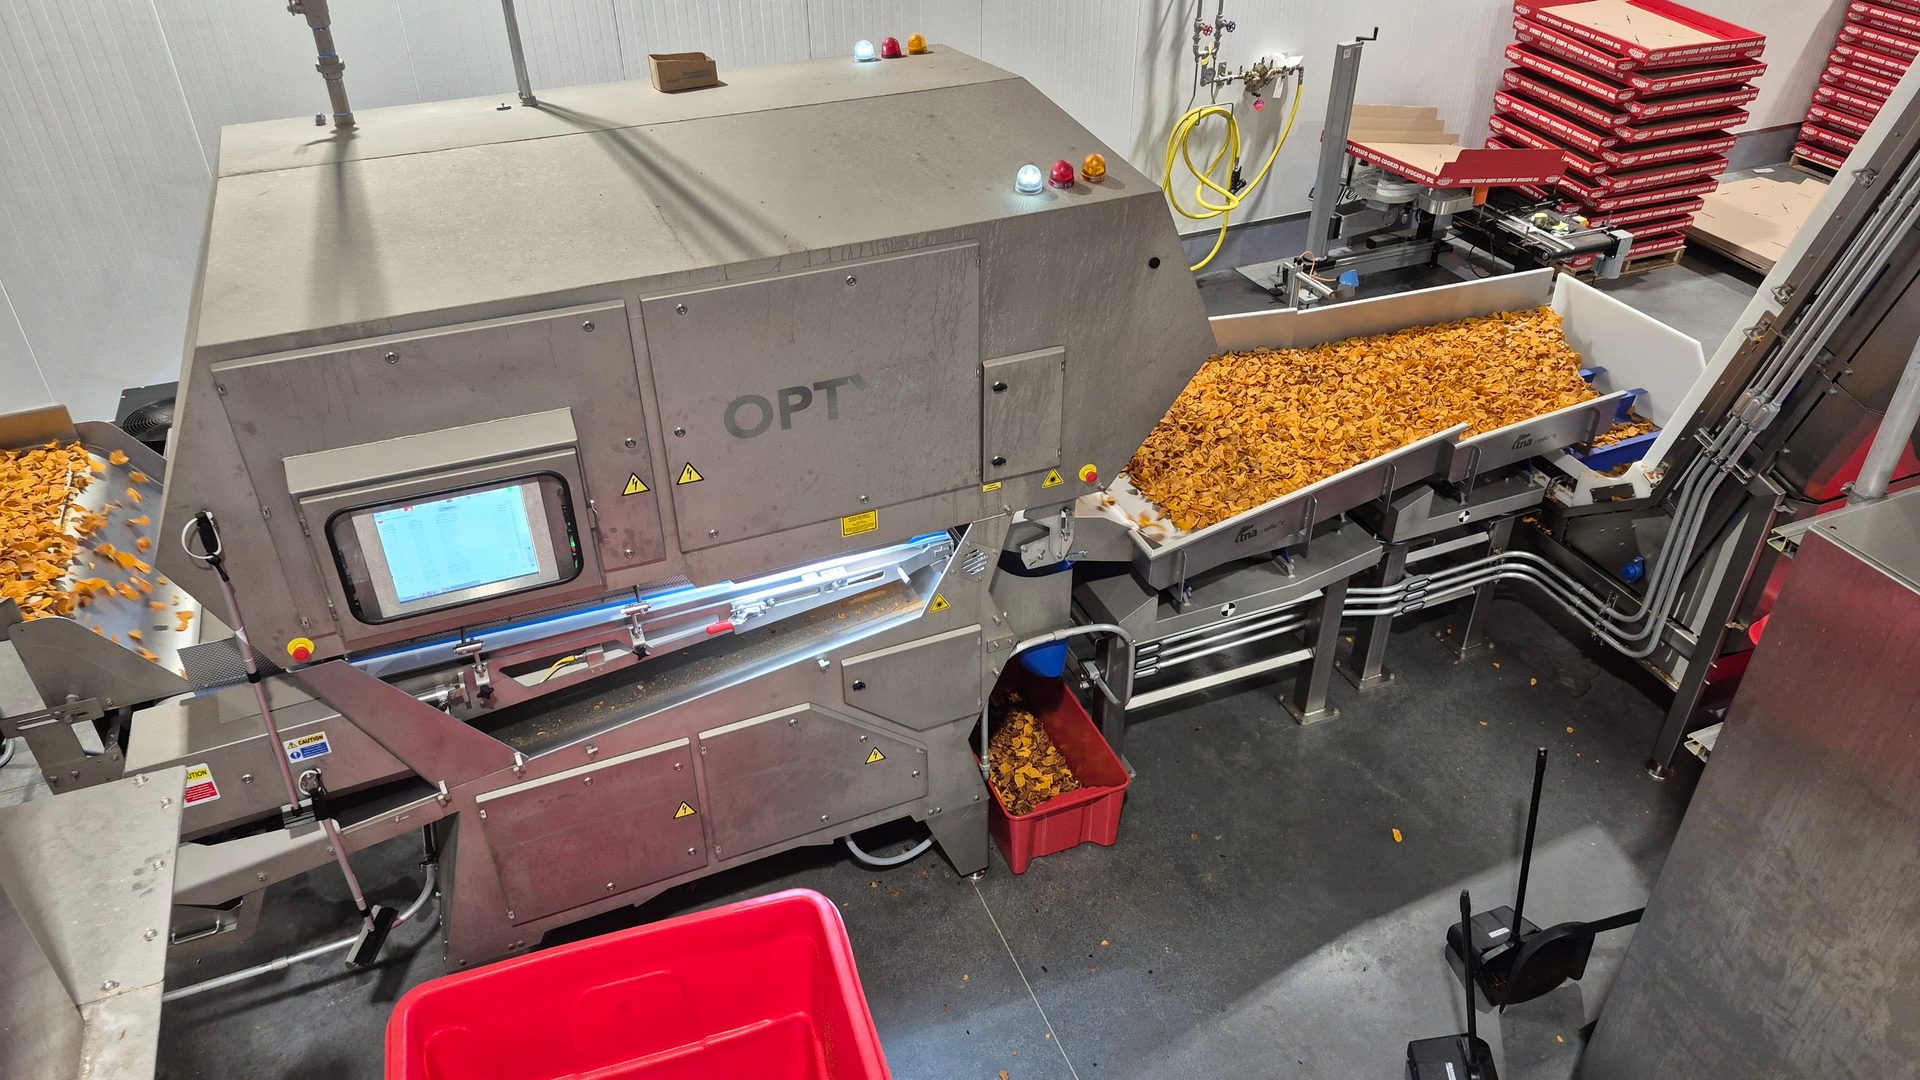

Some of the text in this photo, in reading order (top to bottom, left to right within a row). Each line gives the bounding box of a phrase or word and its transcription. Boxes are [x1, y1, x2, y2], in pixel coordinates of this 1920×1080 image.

[1352, 146, 1367, 156] POTATO
[1368, 152, 1380, 162] CHIPS
[1380, 158, 1399, 169] COOKED
[1404, 168, 1425, 180] AVOCADO
[298, 735, 324, 746] CAUTION
[187, 770, 208, 780] UTION
